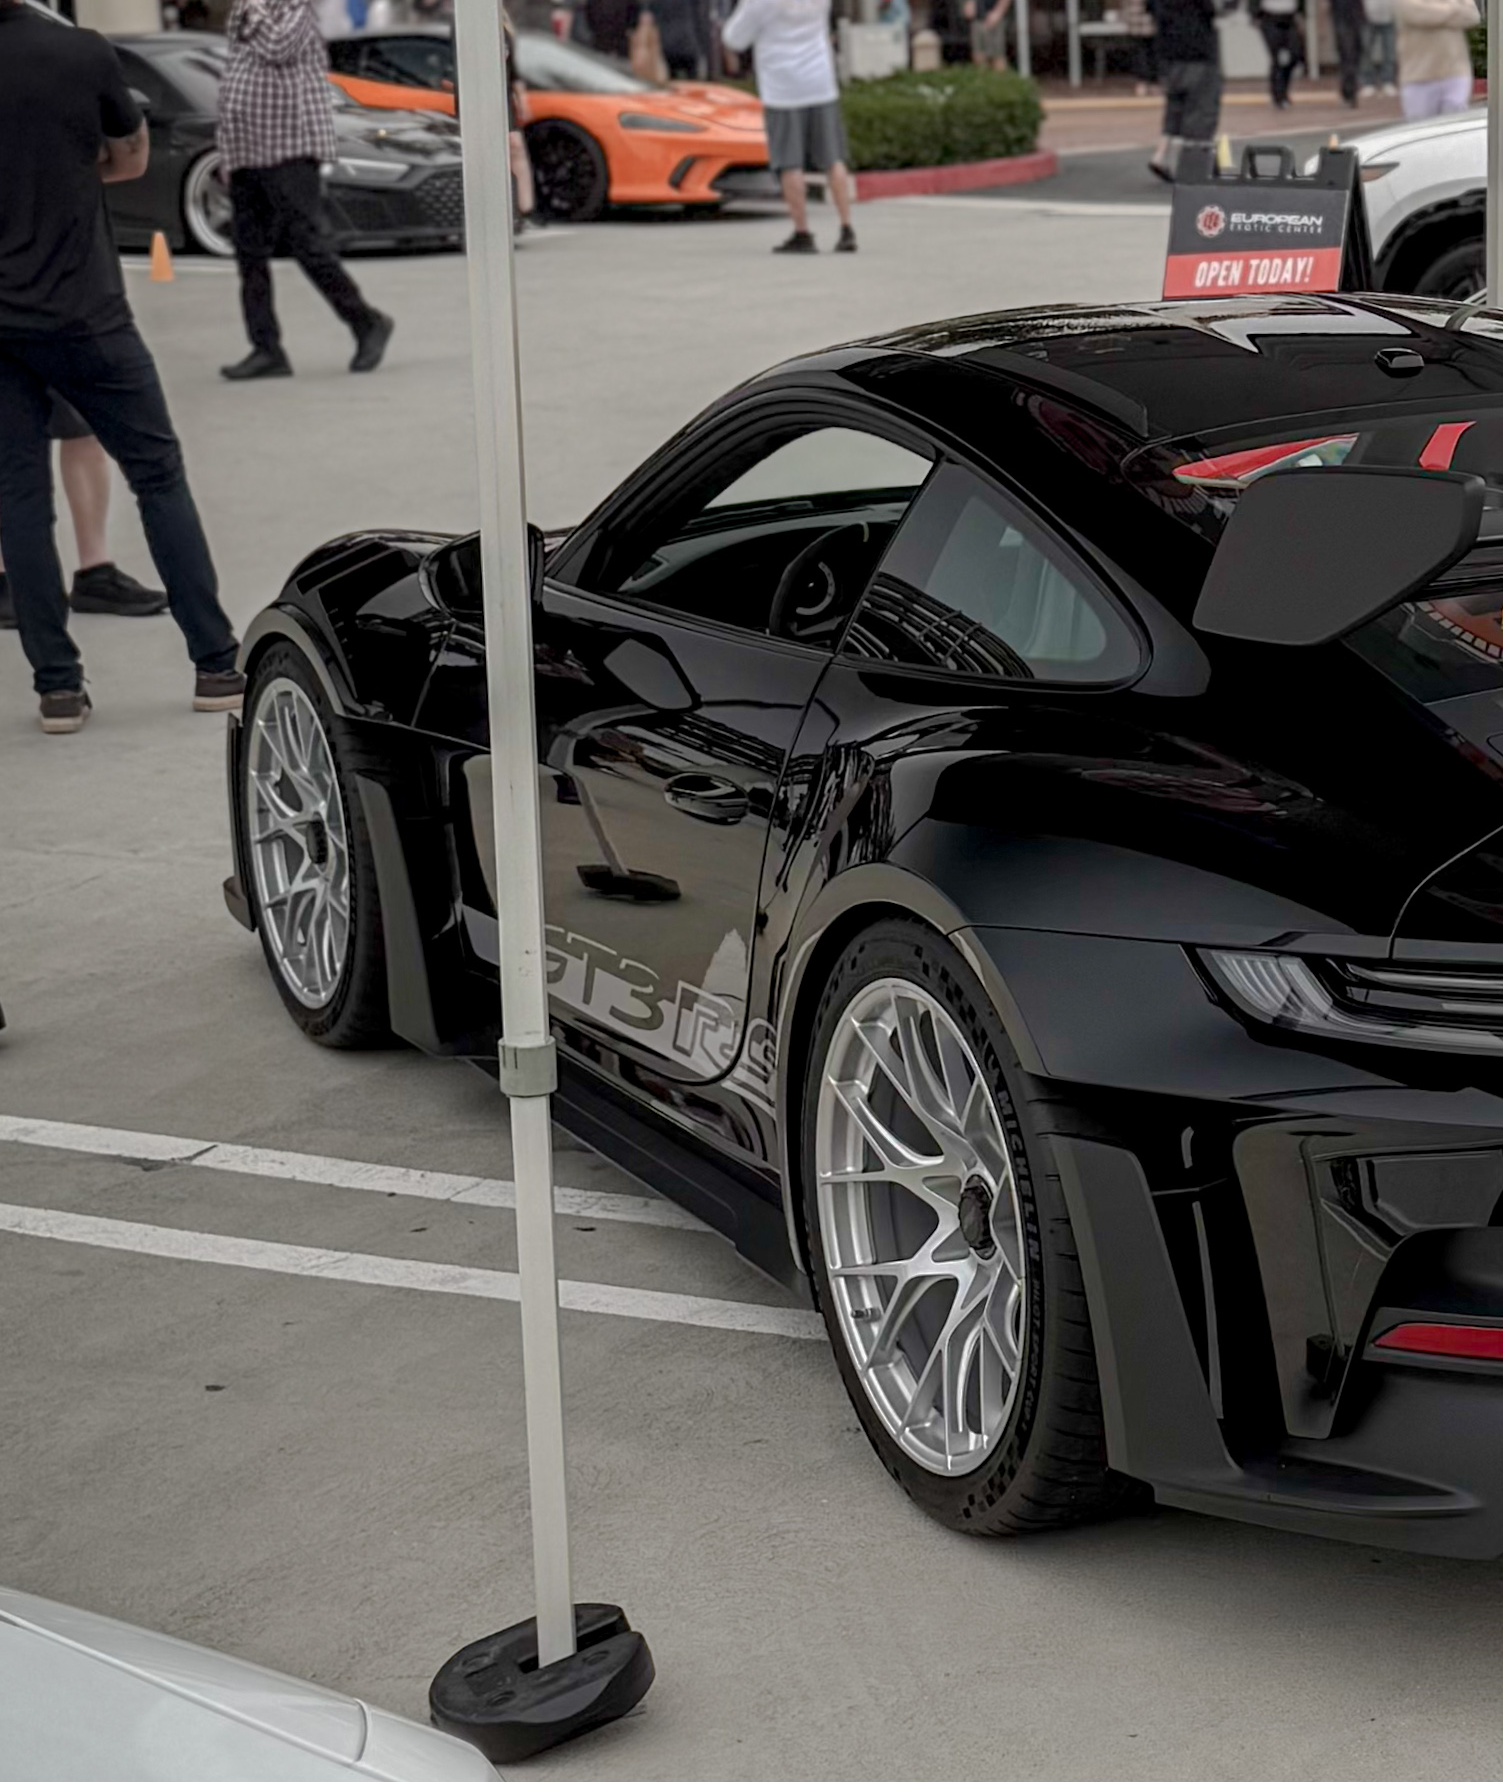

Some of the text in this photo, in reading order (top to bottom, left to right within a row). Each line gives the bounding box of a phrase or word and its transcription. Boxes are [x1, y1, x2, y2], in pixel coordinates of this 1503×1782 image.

[1230, 213, 1323, 226] EUROPEAN
[1230, 223, 1322, 234] EXOTIC CENTER
[1195, 256, 1315, 288] OPEN TODAY!
[997, 1090, 1040, 1261] MICHELIN
